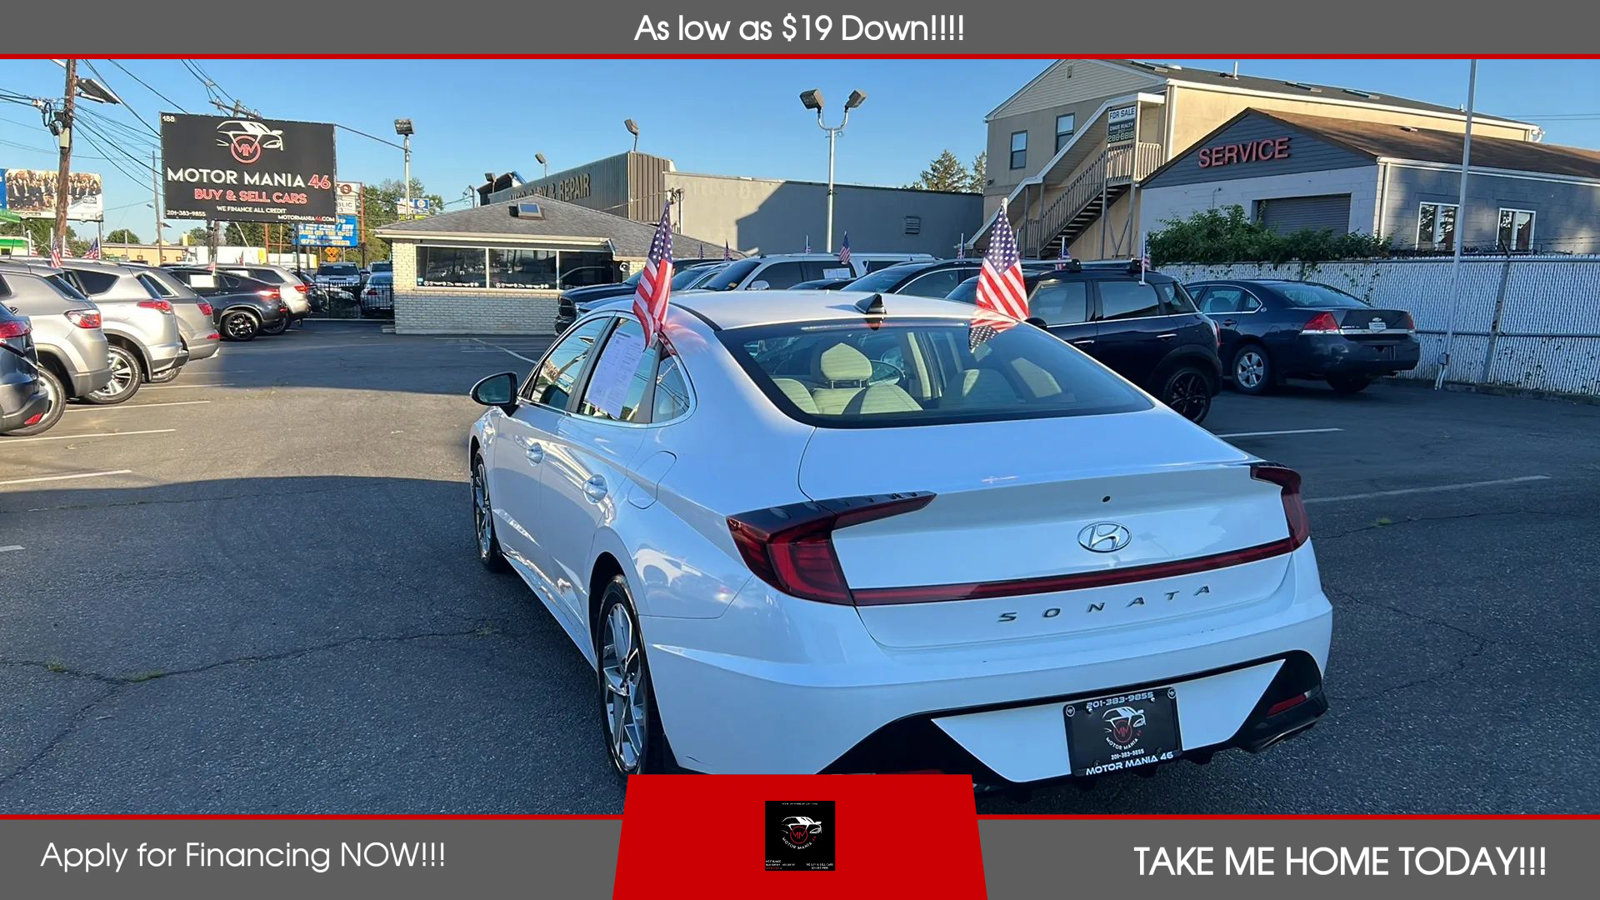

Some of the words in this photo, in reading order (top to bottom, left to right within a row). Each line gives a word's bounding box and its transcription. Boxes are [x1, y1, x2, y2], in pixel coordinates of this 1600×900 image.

[1110, 111, 1119, 119] FOR
[1121, 108, 1135, 117] SALE
[1198, 137, 1291, 168] SERVICE
[167, 167, 238, 184] MOTOR
[243, 171, 306, 188] MANIA
[307, 174, 332, 190] 46
[560, 173, 591, 202] REPAIR
[194, 188, 223, 201] BUY
[226, 189, 236, 201] &
[238, 191, 270, 203] SELL
[272, 192, 308, 205] CARS
[998, 585, 1210, 623] SONATA
[1086, 691, 1154, 710] 201-383-9855
[1106, 736, 1122, 750] MOTOR
[1123, 738, 1138, 750] MANIA
[1086, 761, 1123, 775] MOTOR
[1125, 754, 1158, 768] MANIA
[1160, 751, 1174, 760] 46
